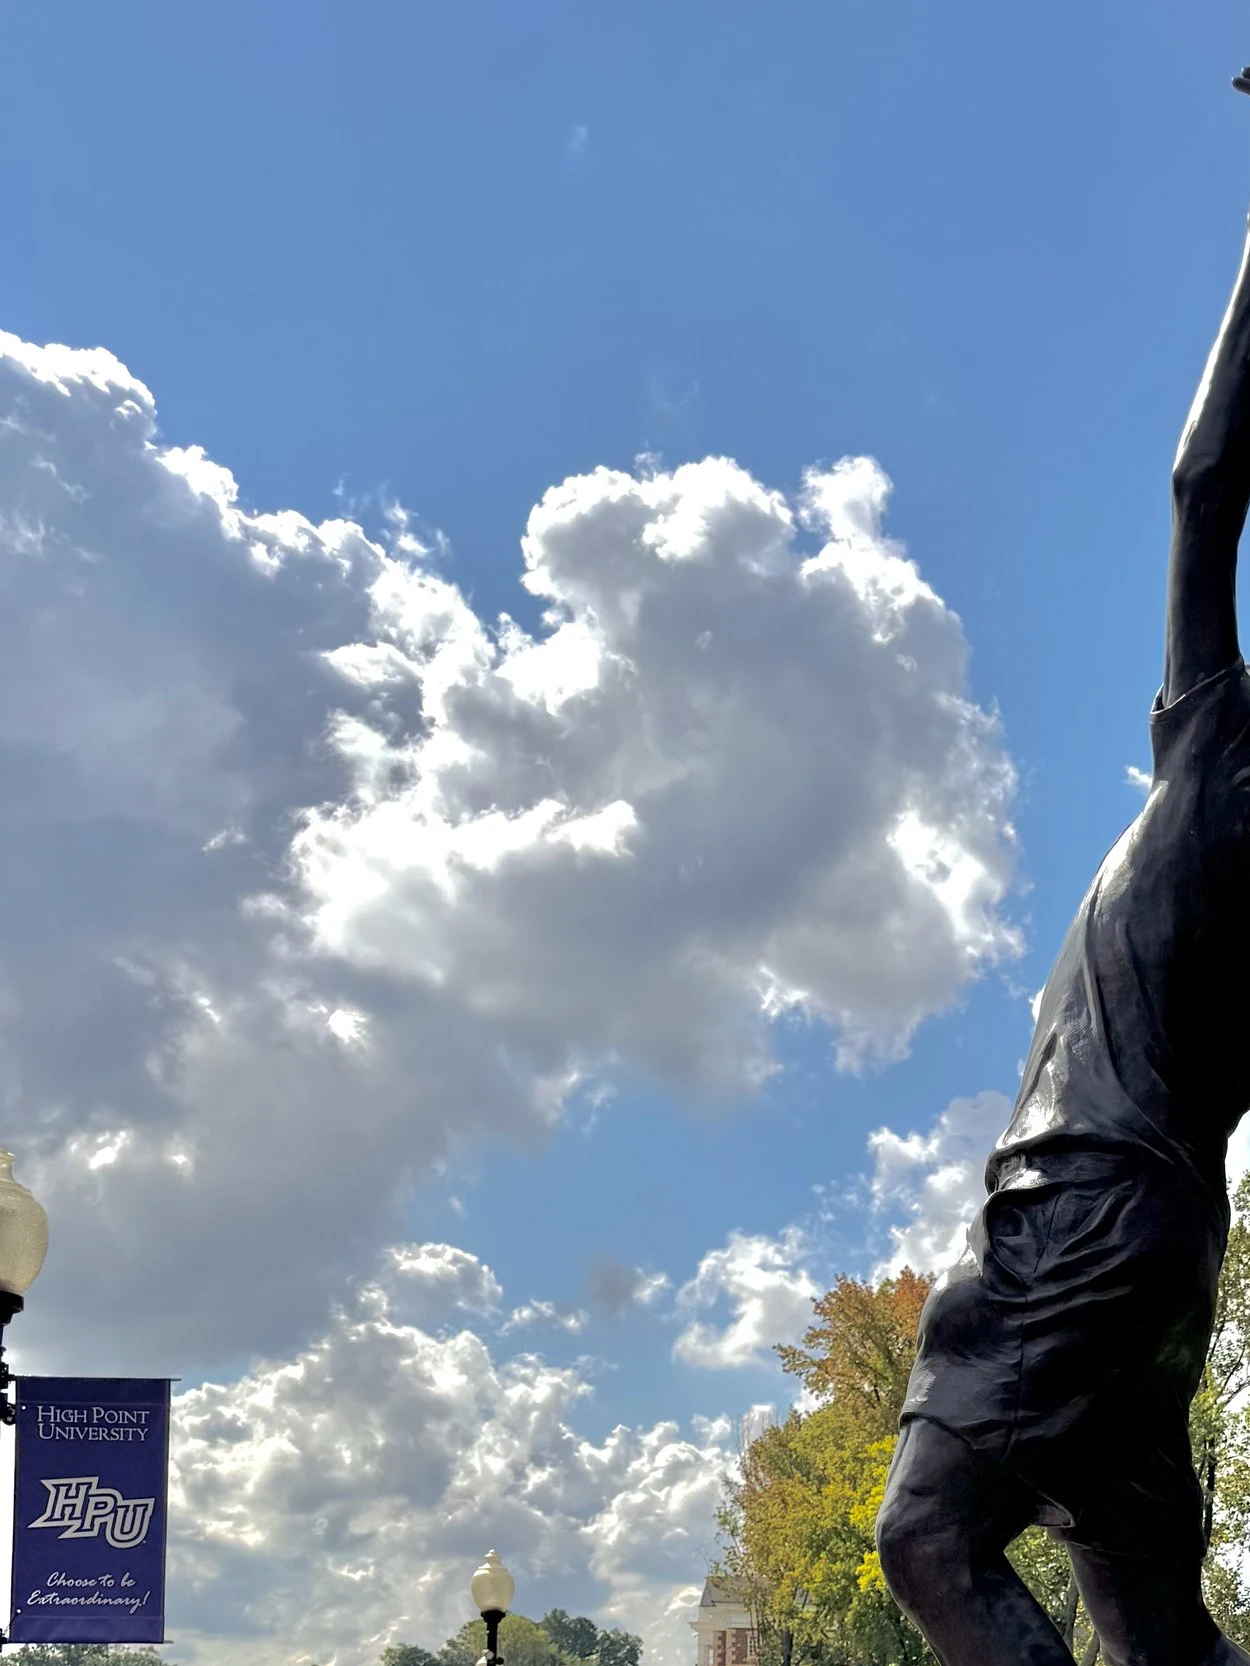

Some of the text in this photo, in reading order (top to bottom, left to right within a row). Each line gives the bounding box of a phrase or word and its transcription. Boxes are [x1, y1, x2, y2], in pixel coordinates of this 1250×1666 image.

[37, 1405, 150, 1424] HIGH POINT
[38, 1423, 149, 1441] UNIVERSITY
[27, 1476, 155, 1549] HPU
[46, 1571, 136, 1587] Choose to be
[26, 1589, 150, 1614] Extraordinary!
